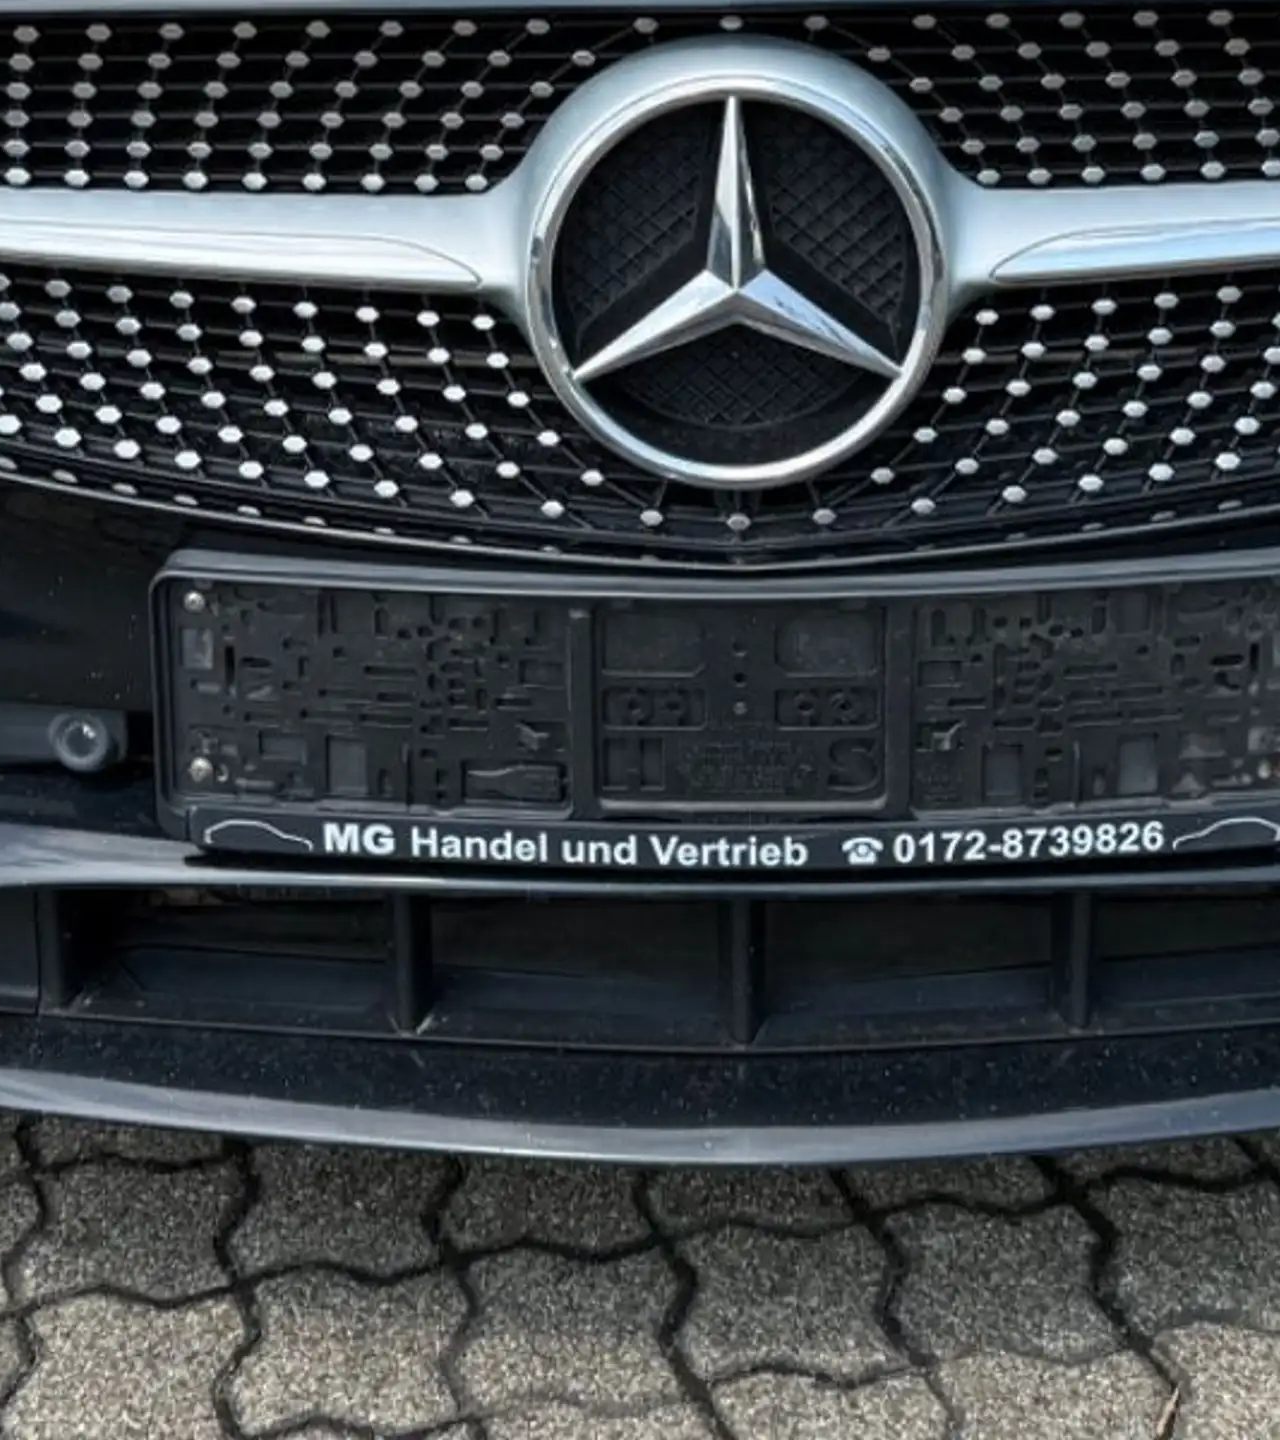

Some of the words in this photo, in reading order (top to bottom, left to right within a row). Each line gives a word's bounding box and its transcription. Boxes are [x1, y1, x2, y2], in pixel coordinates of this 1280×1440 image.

[323, 822, 396, 855] MG
[411, 825, 548, 862] Handel
[562, 834, 637, 865] und
[650, 835, 808, 867] Vertrieb
[893, 821, 1164, 864] 0172-8739826
